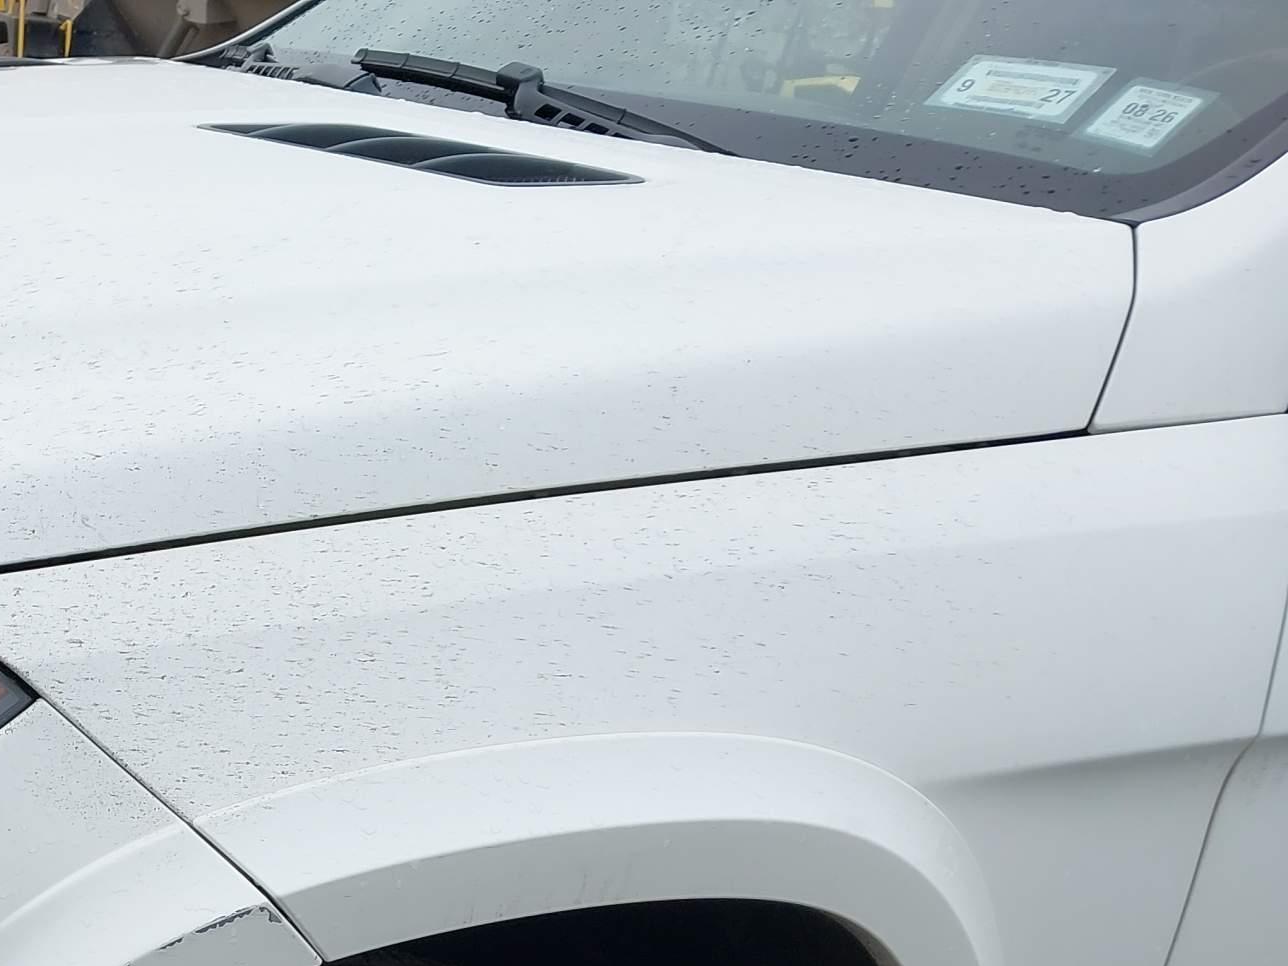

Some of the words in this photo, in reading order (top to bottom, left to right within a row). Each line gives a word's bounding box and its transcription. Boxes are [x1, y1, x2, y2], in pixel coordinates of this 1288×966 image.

[956, 78, 977, 93] 9
[1039, 88, 1078, 105] 27
[1121, 102, 1149, 118] 08
[1149, 108, 1179, 124] 26
